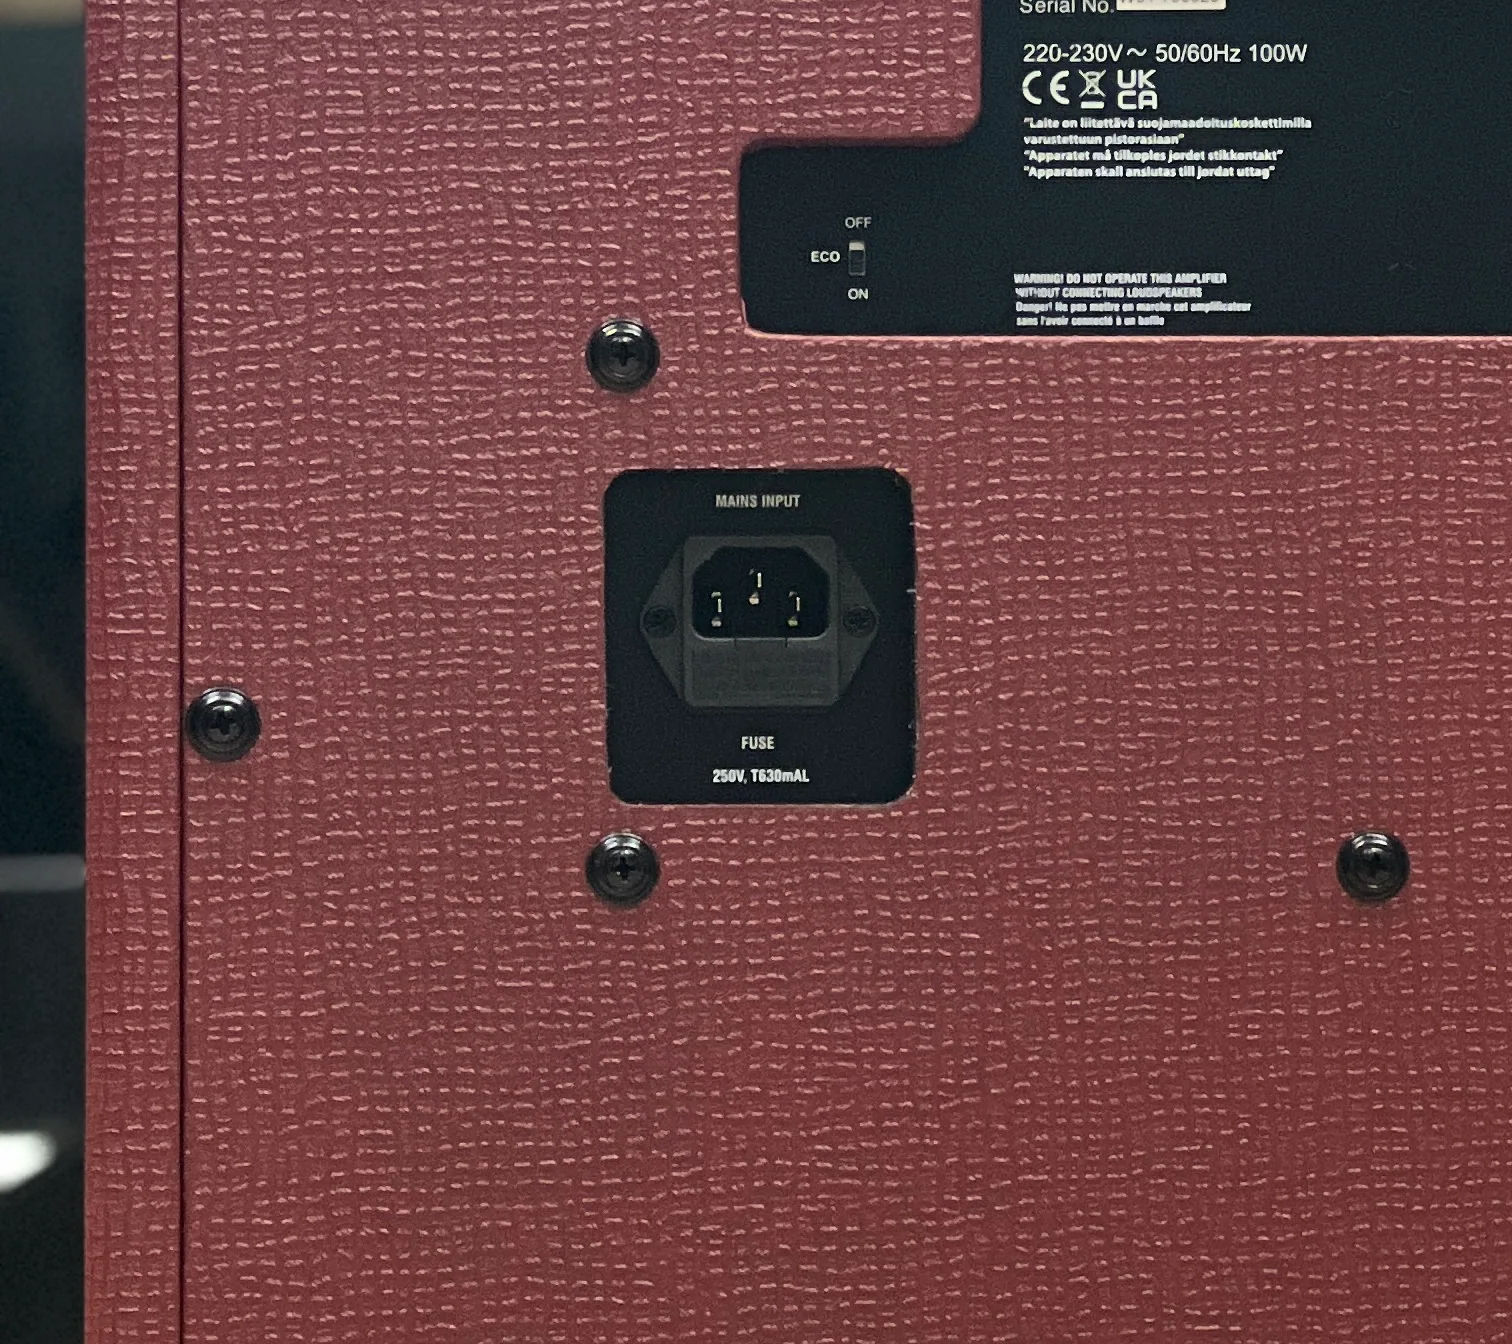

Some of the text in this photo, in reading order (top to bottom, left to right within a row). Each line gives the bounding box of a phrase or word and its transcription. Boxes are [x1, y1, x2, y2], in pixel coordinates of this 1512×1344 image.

[1155, 43, 1241, 63] 50/60Hz
[1249, 43, 1308, 63] 100W
[1117, 69, 1156, 89] UK
[1061, 120, 1078, 129] on
[844, 216, 872, 229] OFF
[811, 250, 841, 263] ECO
[847, 287, 869, 300] ON
[715, 494, 800, 508] MAINS INPUT
[741, 736, 775, 750] FUSE
[712, 769, 810, 784] 250V, T630mAL
